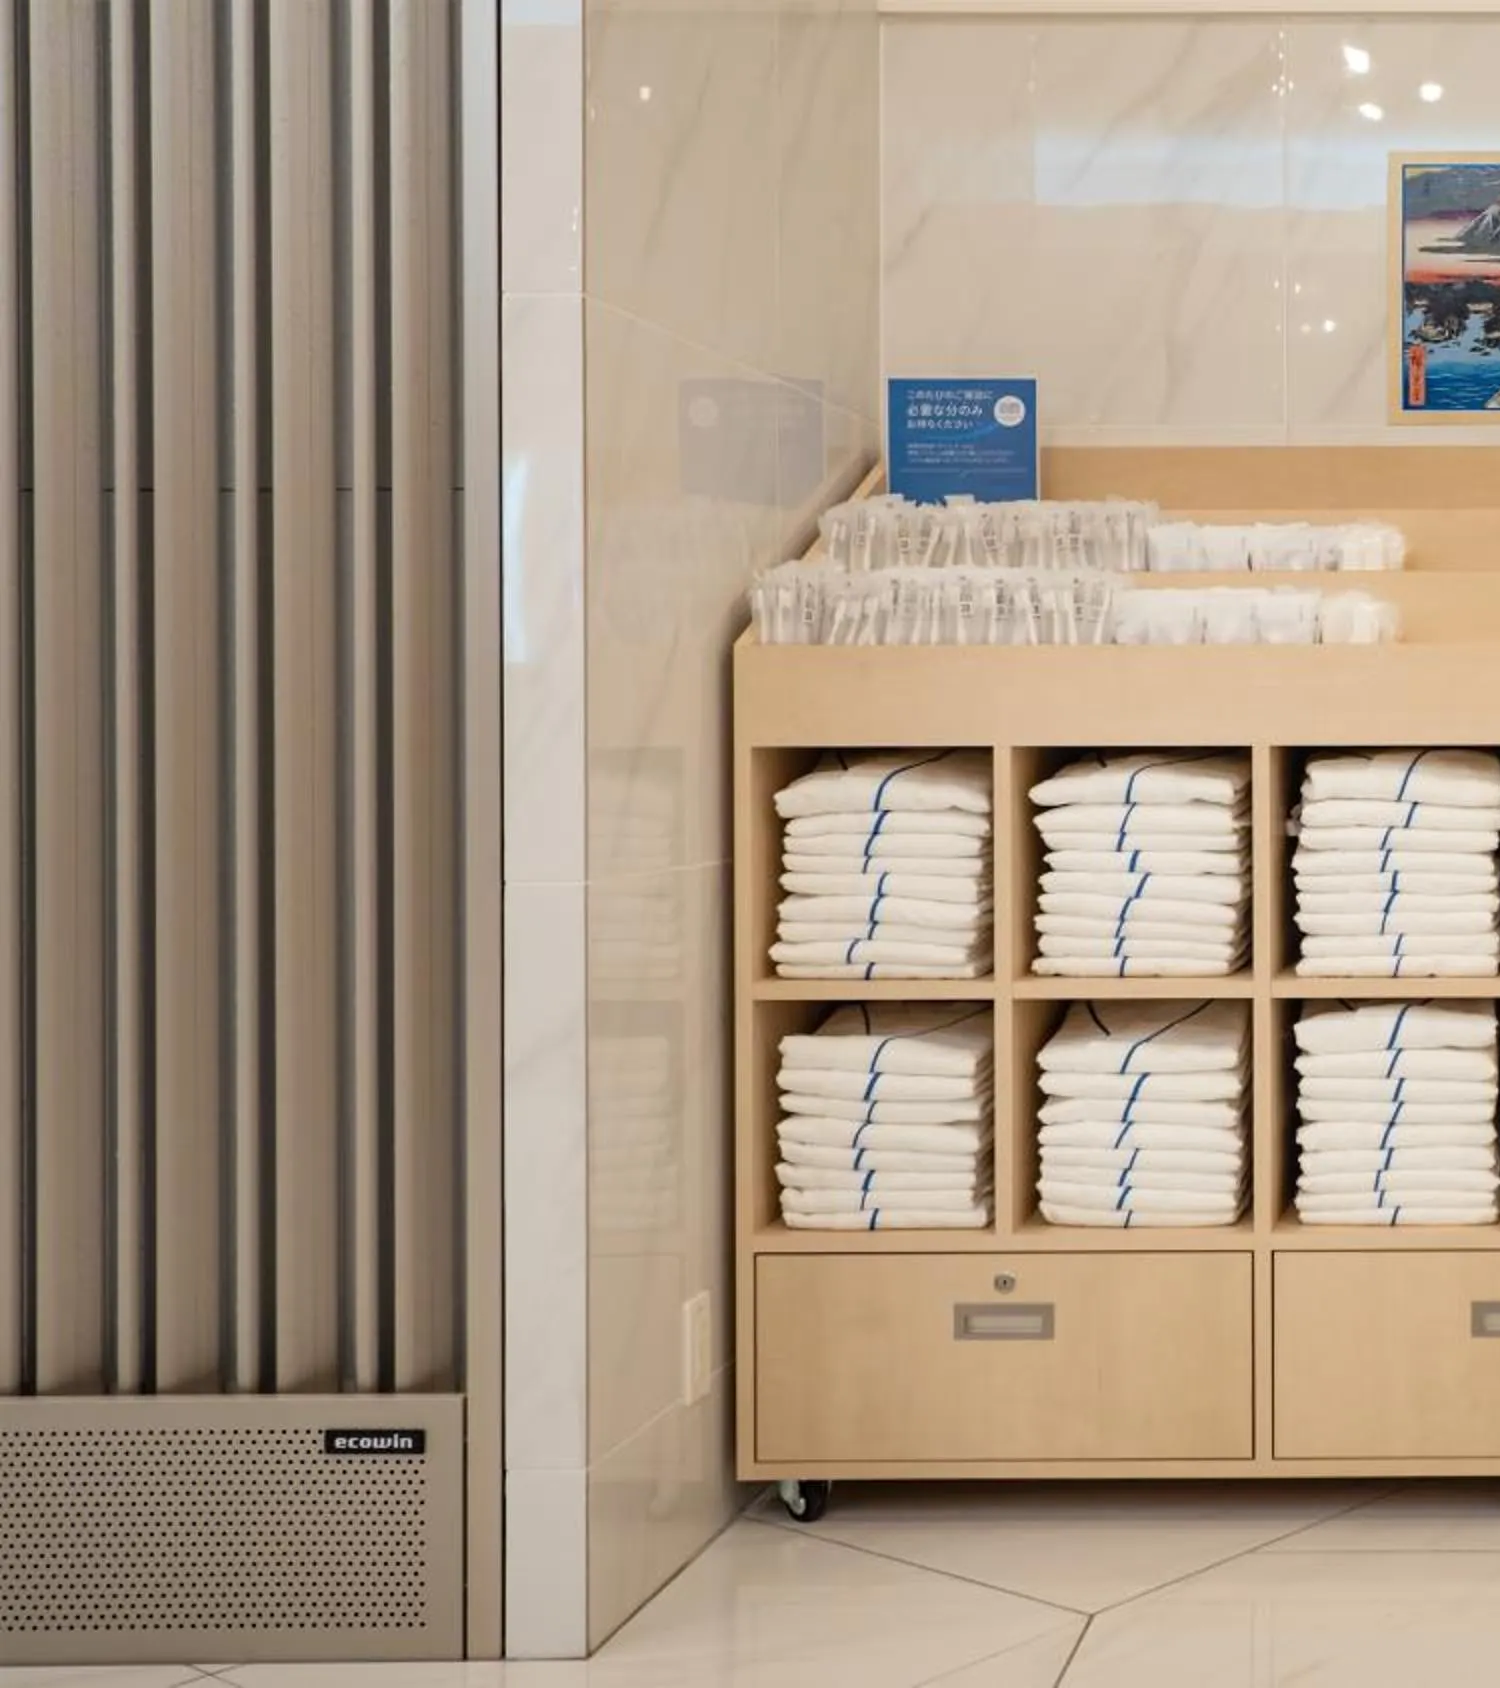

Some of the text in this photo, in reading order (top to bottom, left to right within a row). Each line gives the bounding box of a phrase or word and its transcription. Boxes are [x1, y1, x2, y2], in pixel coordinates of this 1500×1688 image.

[907, 402, 983, 417] 必要な分のみ
[907, 419, 974, 429] お持ちください
[334, 1433, 413, 1449] ecowin
